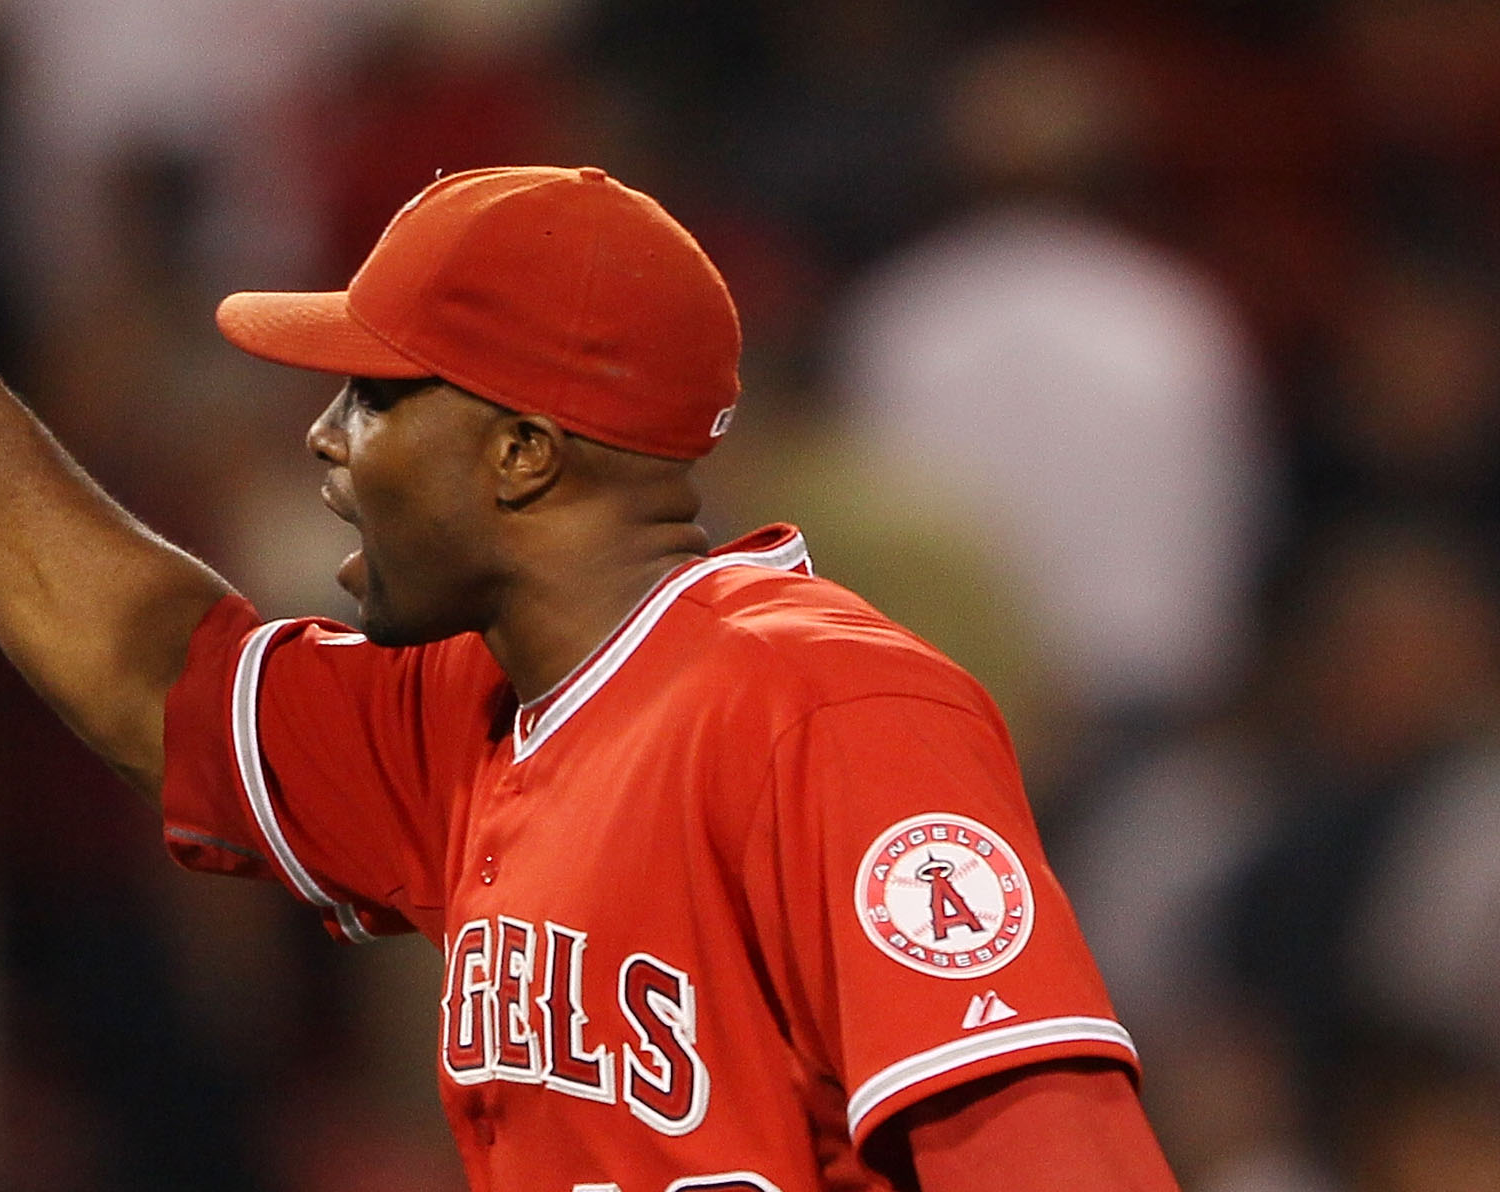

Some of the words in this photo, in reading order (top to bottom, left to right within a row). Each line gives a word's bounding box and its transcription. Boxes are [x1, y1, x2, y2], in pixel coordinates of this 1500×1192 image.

[873, 825, 994, 881] ANGELS
[889, 904, 1023, 967] BASEBALL
[442, 915, 710, 1136] GELS
